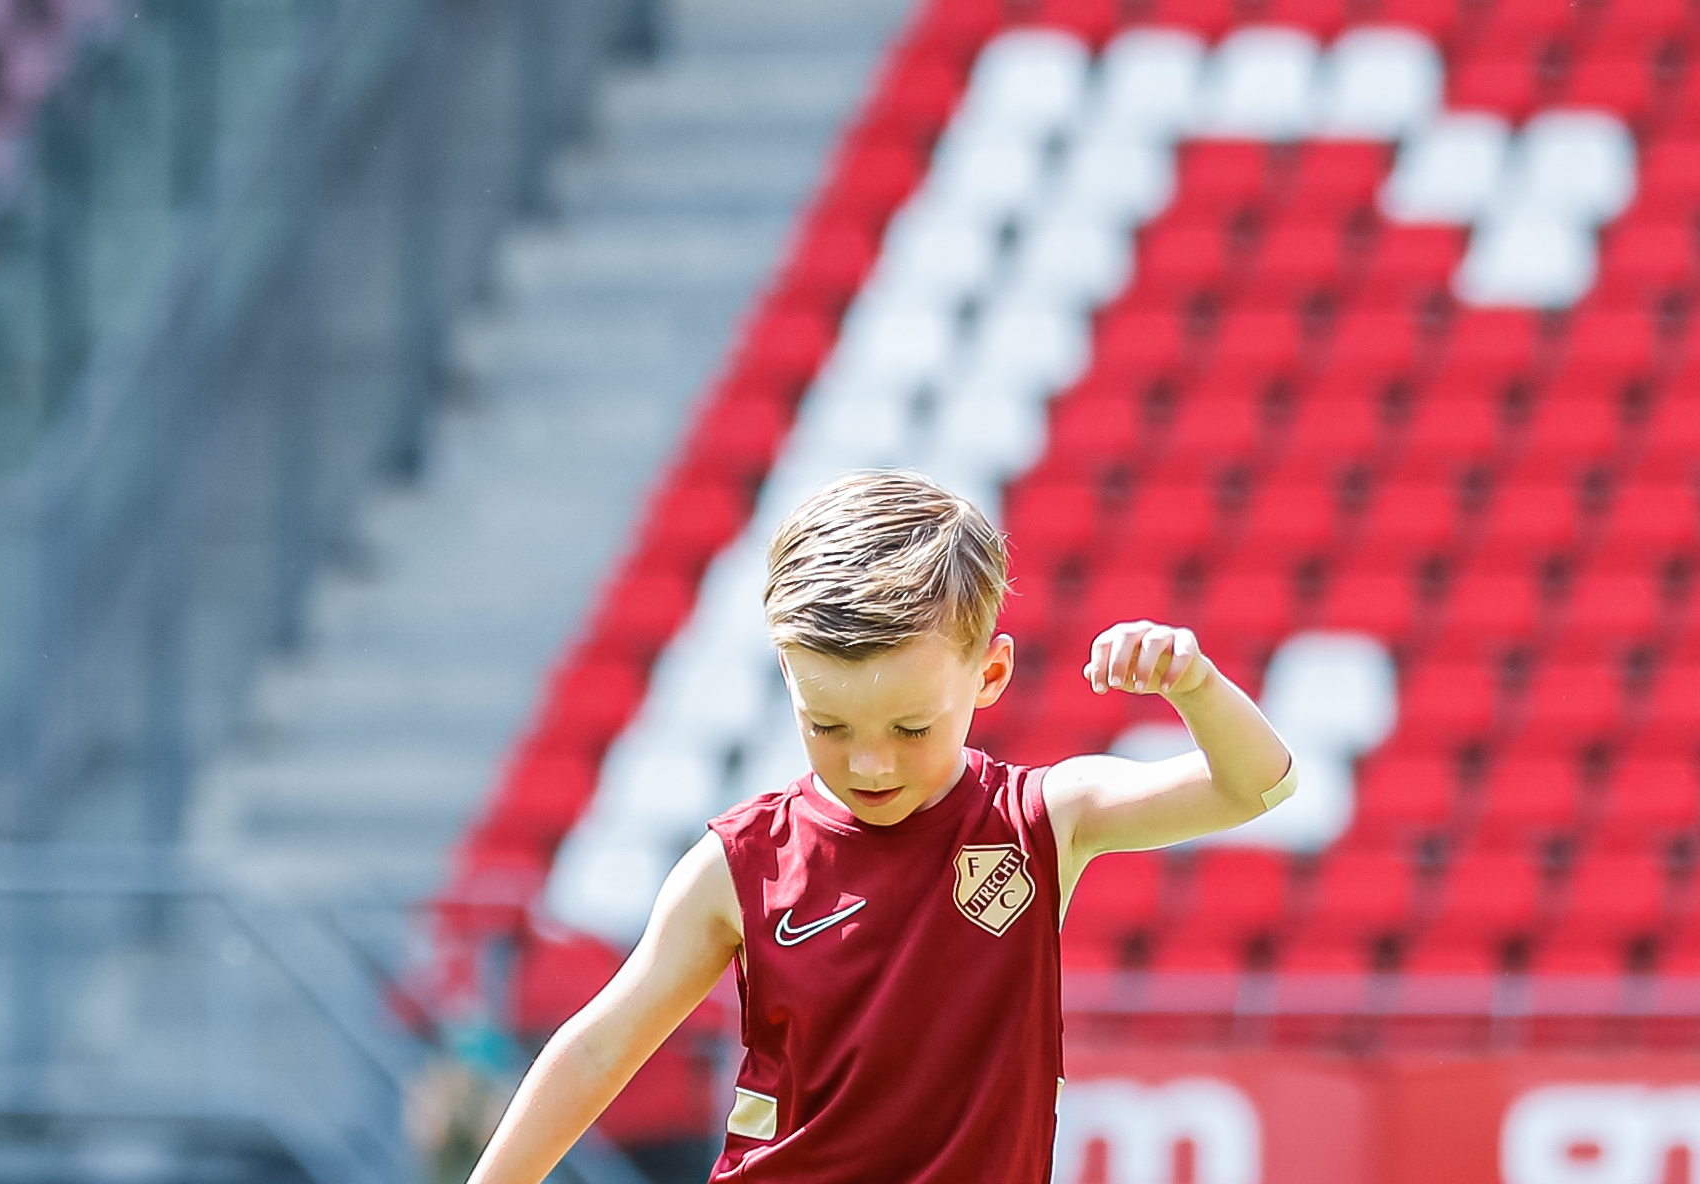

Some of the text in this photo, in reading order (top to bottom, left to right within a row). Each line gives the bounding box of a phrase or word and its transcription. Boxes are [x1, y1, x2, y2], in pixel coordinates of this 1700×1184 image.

[967, 857, 980, 878] F
[964, 851, 1021, 917] UTRECHT
[998, 889, 1019, 910] C
